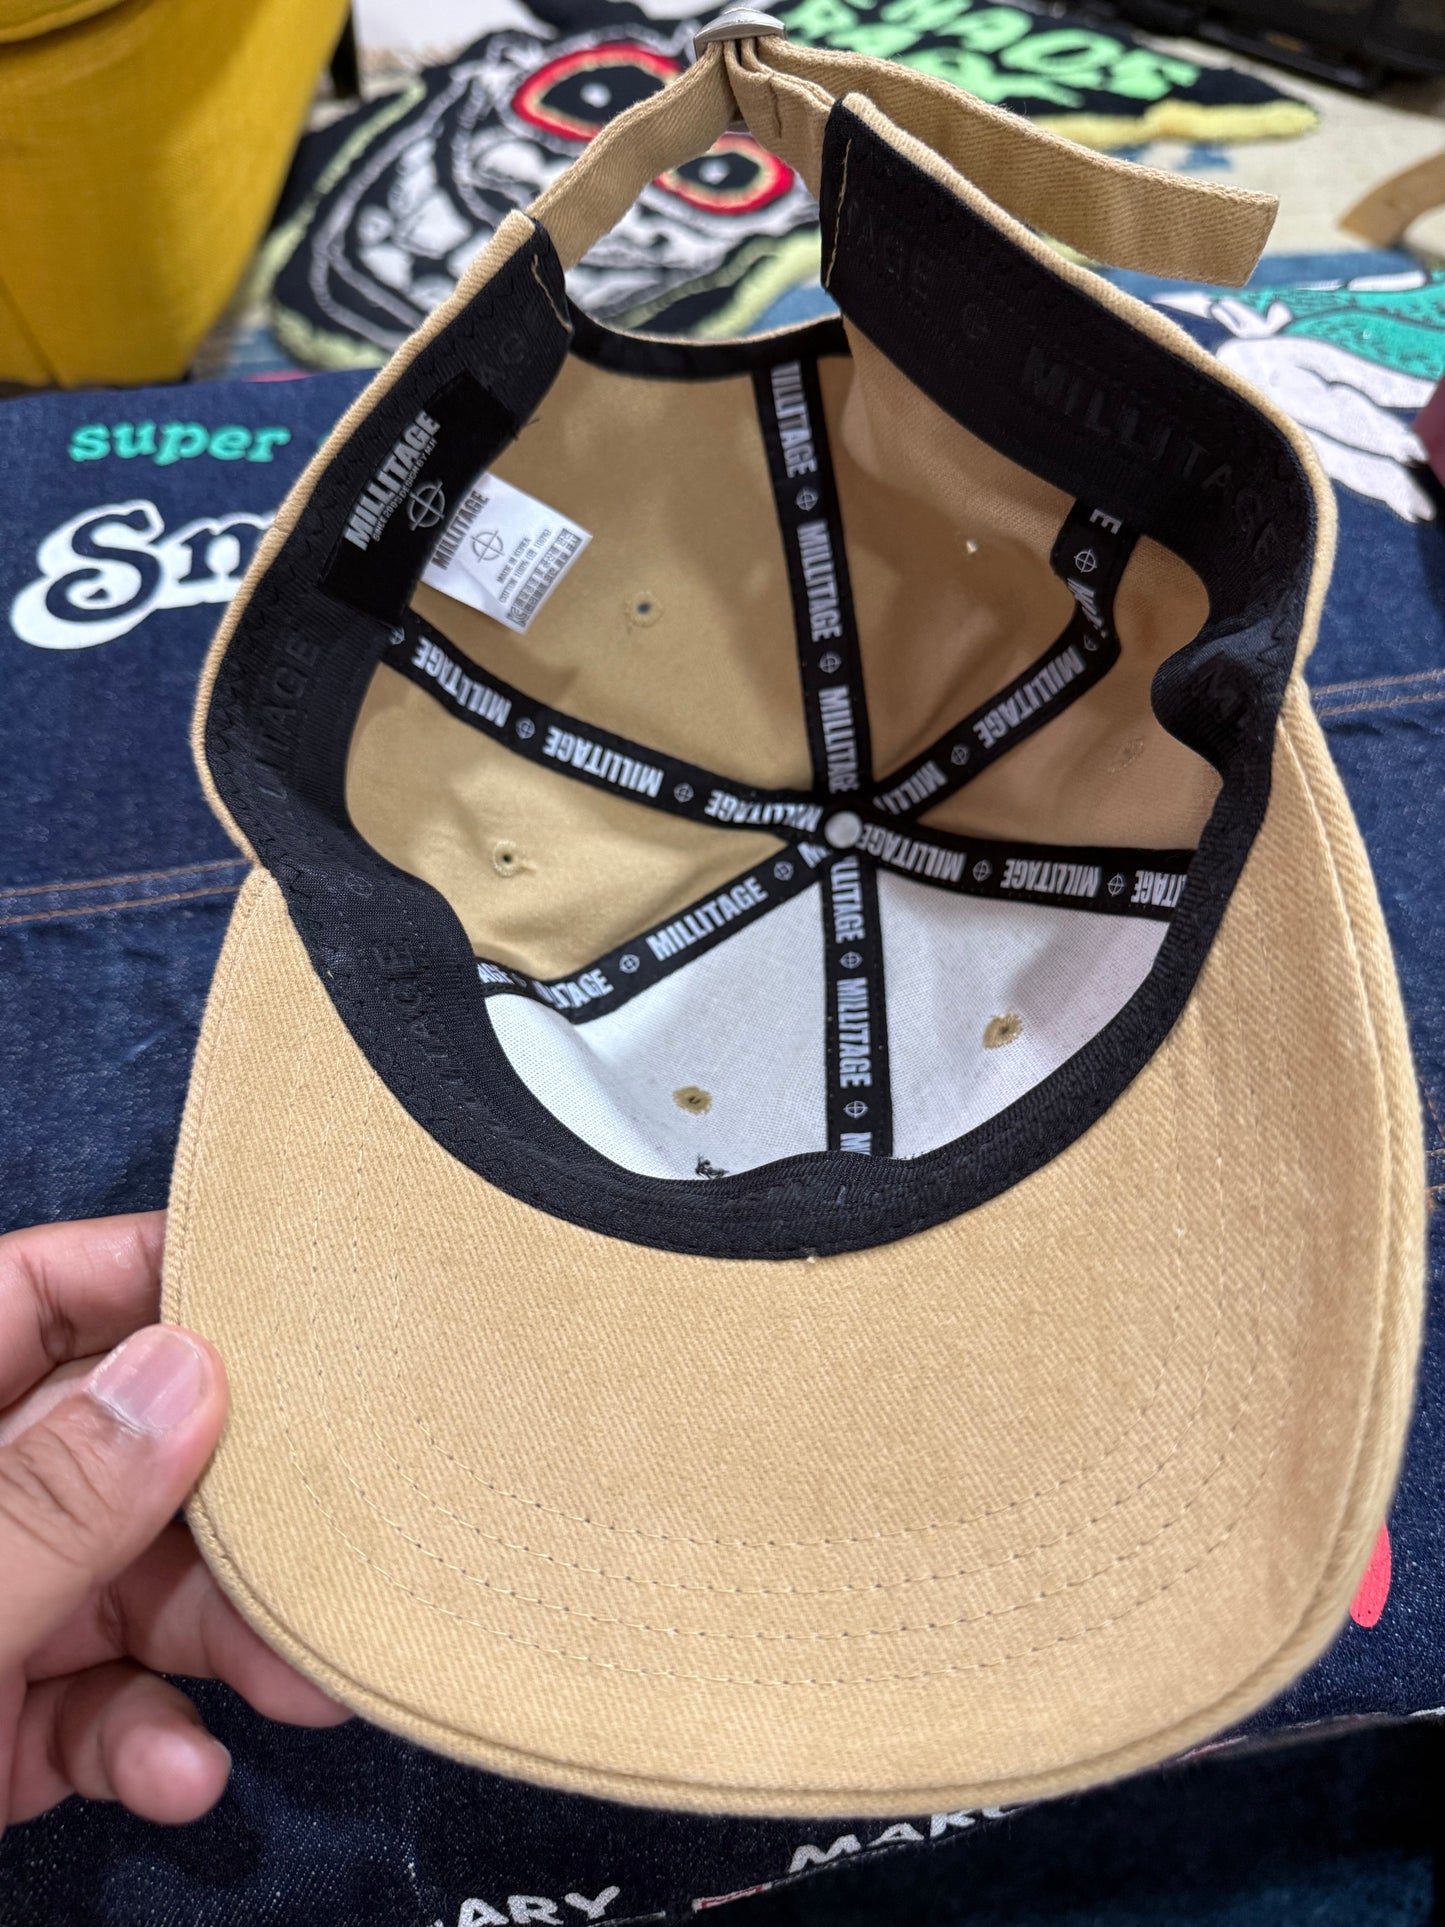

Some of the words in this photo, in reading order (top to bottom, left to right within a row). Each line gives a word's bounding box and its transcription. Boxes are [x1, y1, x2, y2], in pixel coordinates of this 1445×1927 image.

[69, 420, 291, 466] super
[344, 410, 441, 551] MILLITAGE
[400, 468, 421, 499] DESIGN
[431, 490, 490, 570] MILLITAGE
[797, 519, 843, 641] MILLITAGE
[412, 635, 512, 728] MILLITAGE
[543, 726, 665, 798] MILLITAGE
[972, 646, 1085, 749] MILLITAGE
[873, 760, 947, 816] MILLI
[856, 823, 967, 883] MILLITAGE
[1000, 858, 1102, 898] MILLITAGE
[1131, 870, 1188, 908] ITAGE
[646, 876, 769, 962] MILLITAGE
[836, 977, 872, 1089] MILLITAGE
[428, 1885, 620, 1927] ARY
